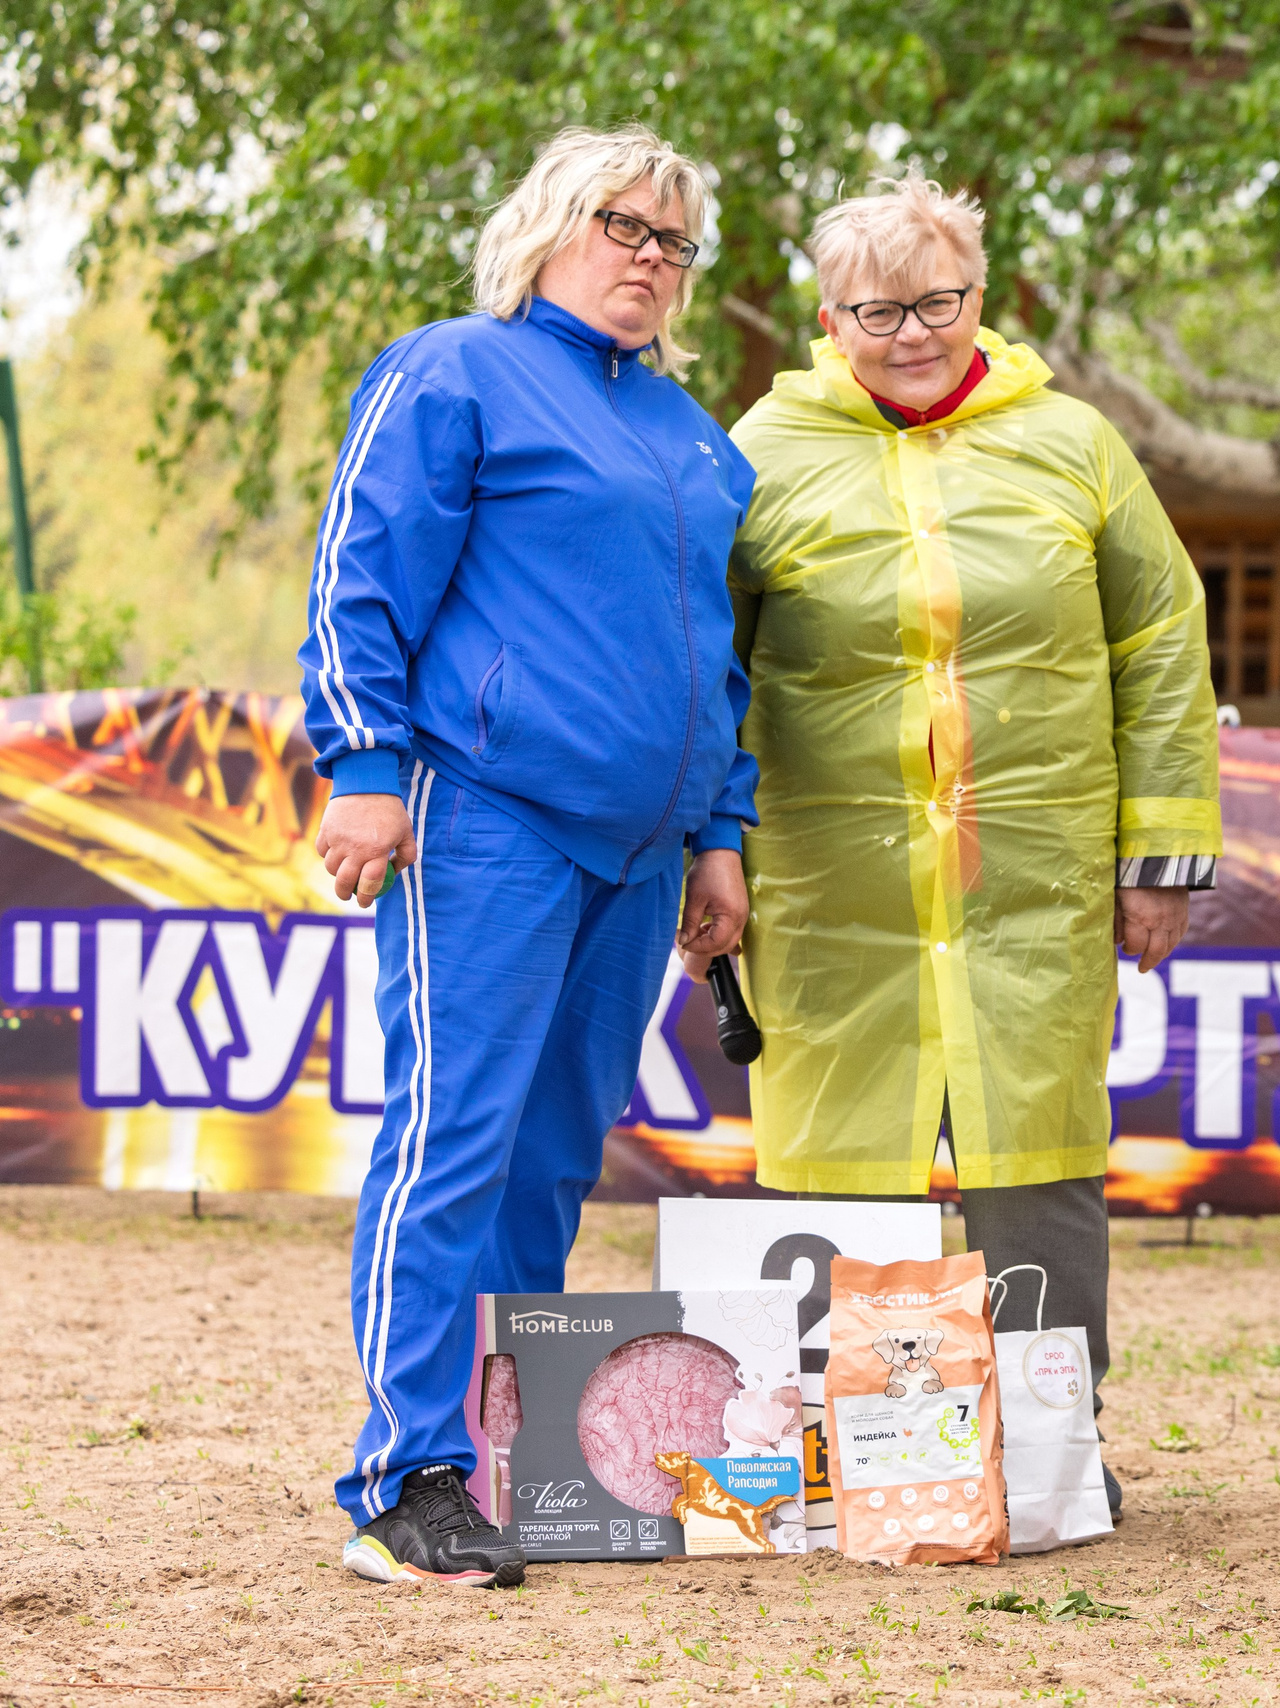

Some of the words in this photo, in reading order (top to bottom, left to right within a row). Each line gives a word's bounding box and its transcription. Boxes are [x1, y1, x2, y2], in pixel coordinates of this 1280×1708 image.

[760, 1233, 842, 1374] 2
[509, 1312, 614, 1334] HOMECLUB
[1044, 1352, 1065, 1361] СРОО
[956, 1404, 970, 1422] 7
[853, 1430, 898, 1442] ИНДЕЙКА
[726, 1460, 792, 1474] Поволжская
[728, 1475, 778, 1490] Рапсодия
[517, 1480, 588, 1509] Viola
[518, 1525, 555, 1533] ТАРЕЛКА
[555, 1524, 573, 1533] ДЛЯ
[573, 1523, 600, 1532] ТОРТА
[519, 1533, 526, 1541] С
[526, 1531, 571, 1541] ЛОПАТКОЙ
